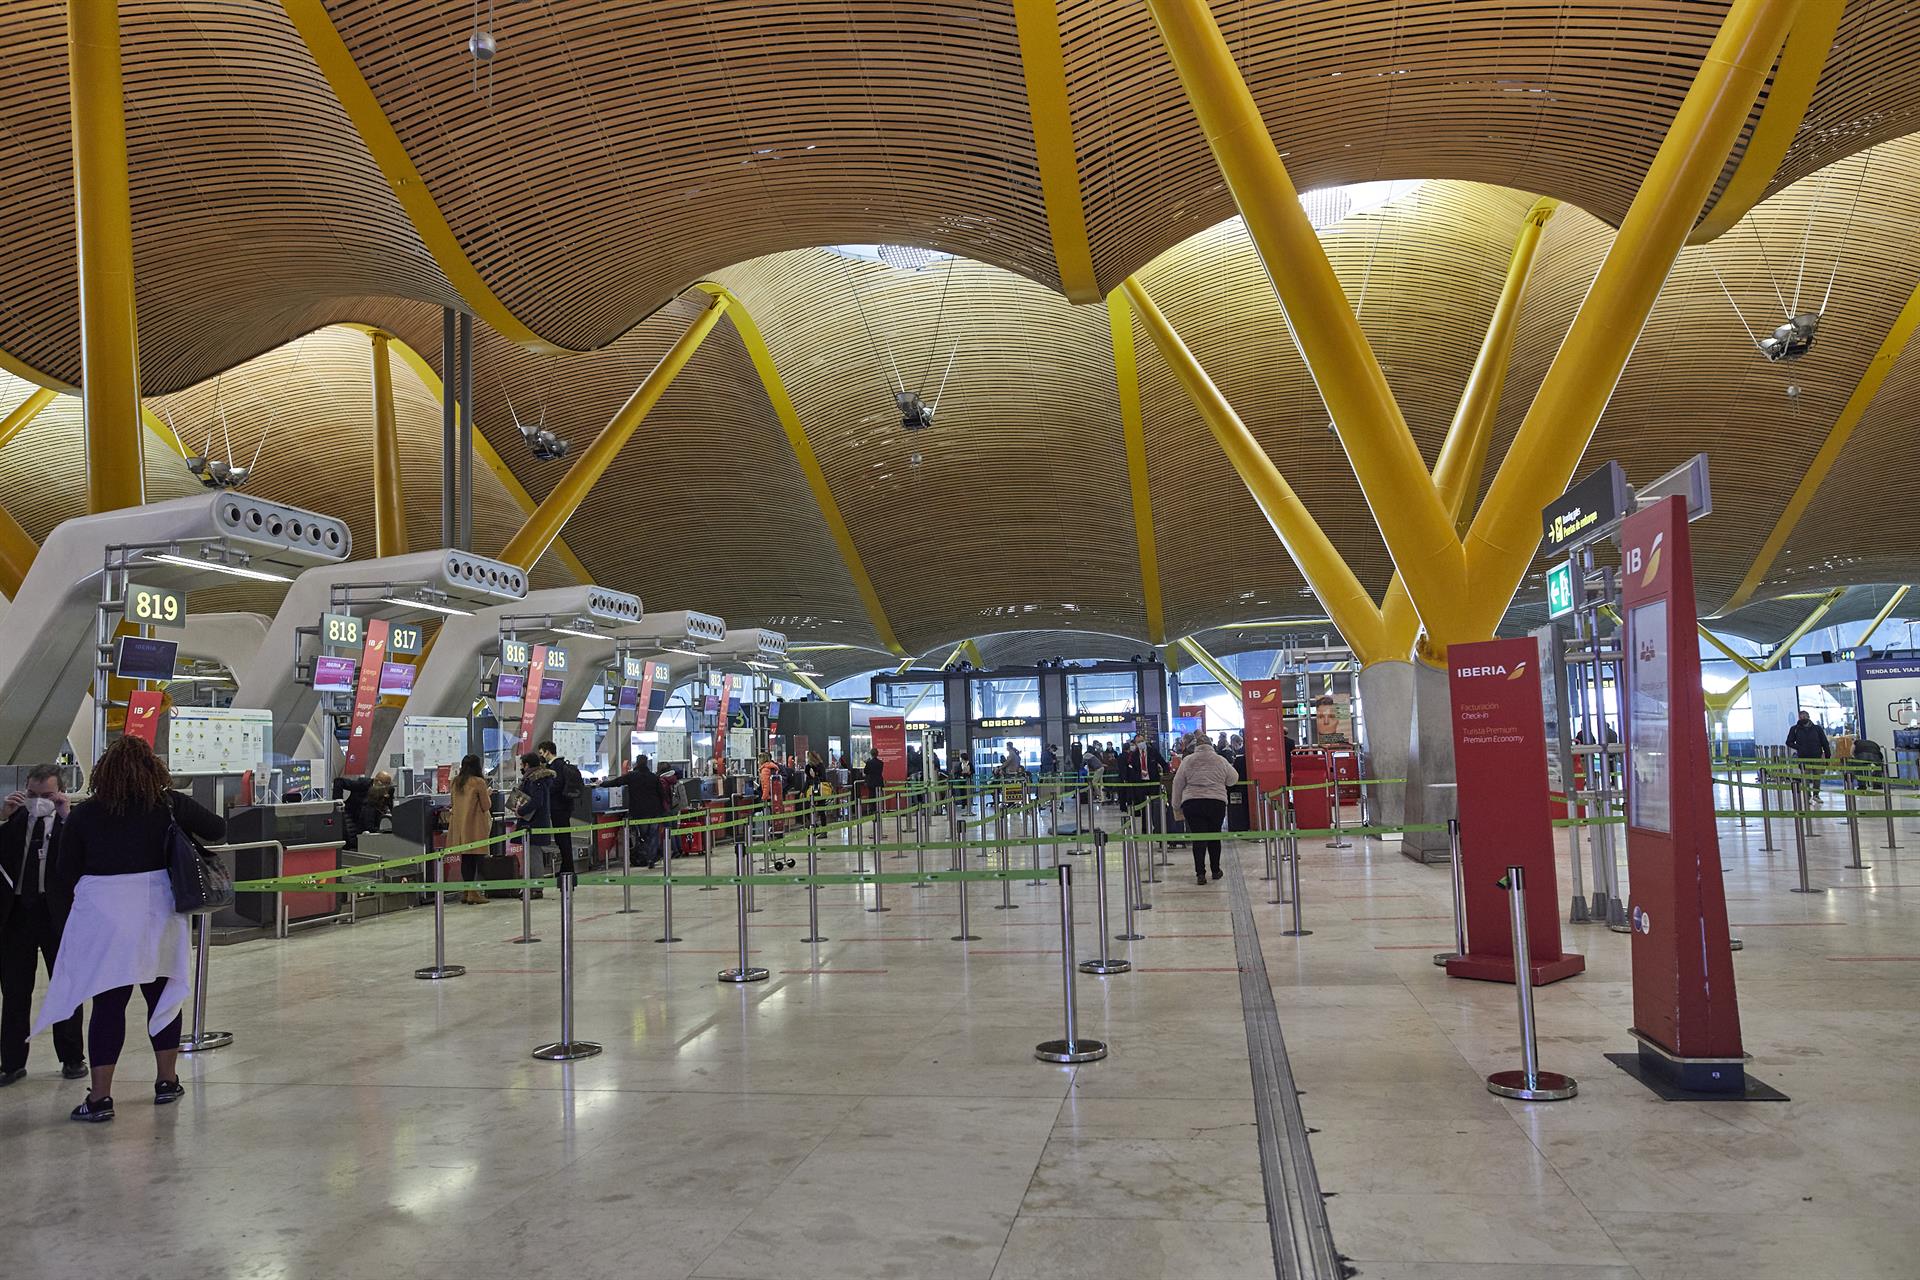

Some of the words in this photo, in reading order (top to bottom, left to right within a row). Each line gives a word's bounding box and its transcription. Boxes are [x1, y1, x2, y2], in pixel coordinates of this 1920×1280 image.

[1626, 547, 1642, 575] IB
[136, 591, 178, 621] 819
[329, 620, 357, 643] 818
[393, 629, 417, 649] 817
[506, 644, 525, 663] 816
[548, 650, 565, 668] 815
[627, 662, 640, 677] 814
[655, 665, 668, 680] 813
[1457, 665, 1507, 678] IBERIA
[710, 673, 721, 687] 812
[732, 675, 742, 689] 811
[1248, 690, 1261, 699] IB
[133, 706, 144, 714] IB
[1461, 702, 1500, 711] Facturación
[1461, 712, 1489, 720] Check-in
[1463, 727, 1486, 736] Turista
[1486, 726, 1518, 735] Premium
[1463, 736, 1493, 744] Premium
[1493, 735, 1525, 744] Economy
